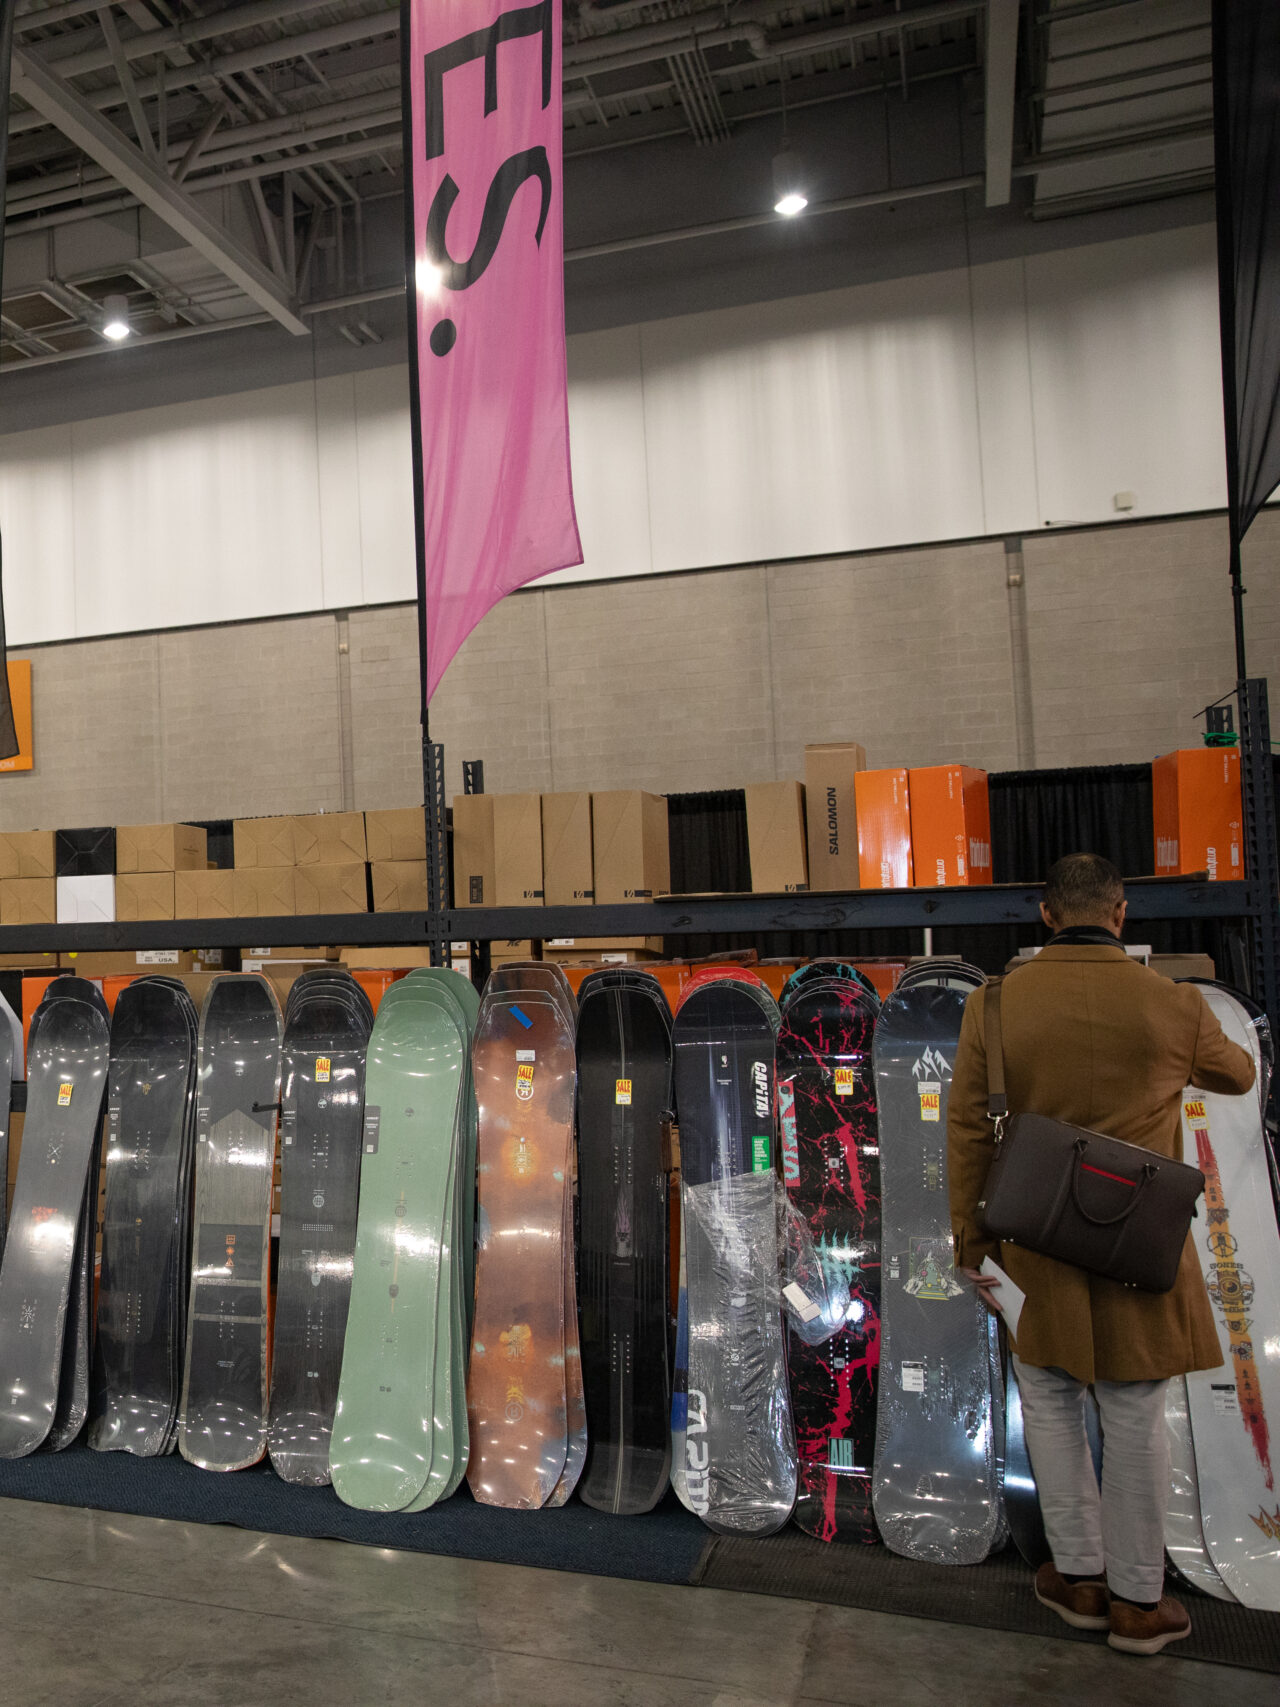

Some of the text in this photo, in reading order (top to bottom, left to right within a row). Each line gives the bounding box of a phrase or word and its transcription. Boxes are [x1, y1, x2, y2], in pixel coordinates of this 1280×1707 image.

[827, 787, 838, 855] SALOMON
[316, 1059, 330, 1070] SALE
[518, 1065, 532, 1079] SALE
[835, 1069, 851, 1083] SALE
[60, 1084, 72, 1096] SALE
[616, 1080, 631, 1092] SALE
[921, 1095, 938, 1108] SALE
[1184, 1102, 1206, 1118] SALE
[830, 1439, 854, 1471] AIR
